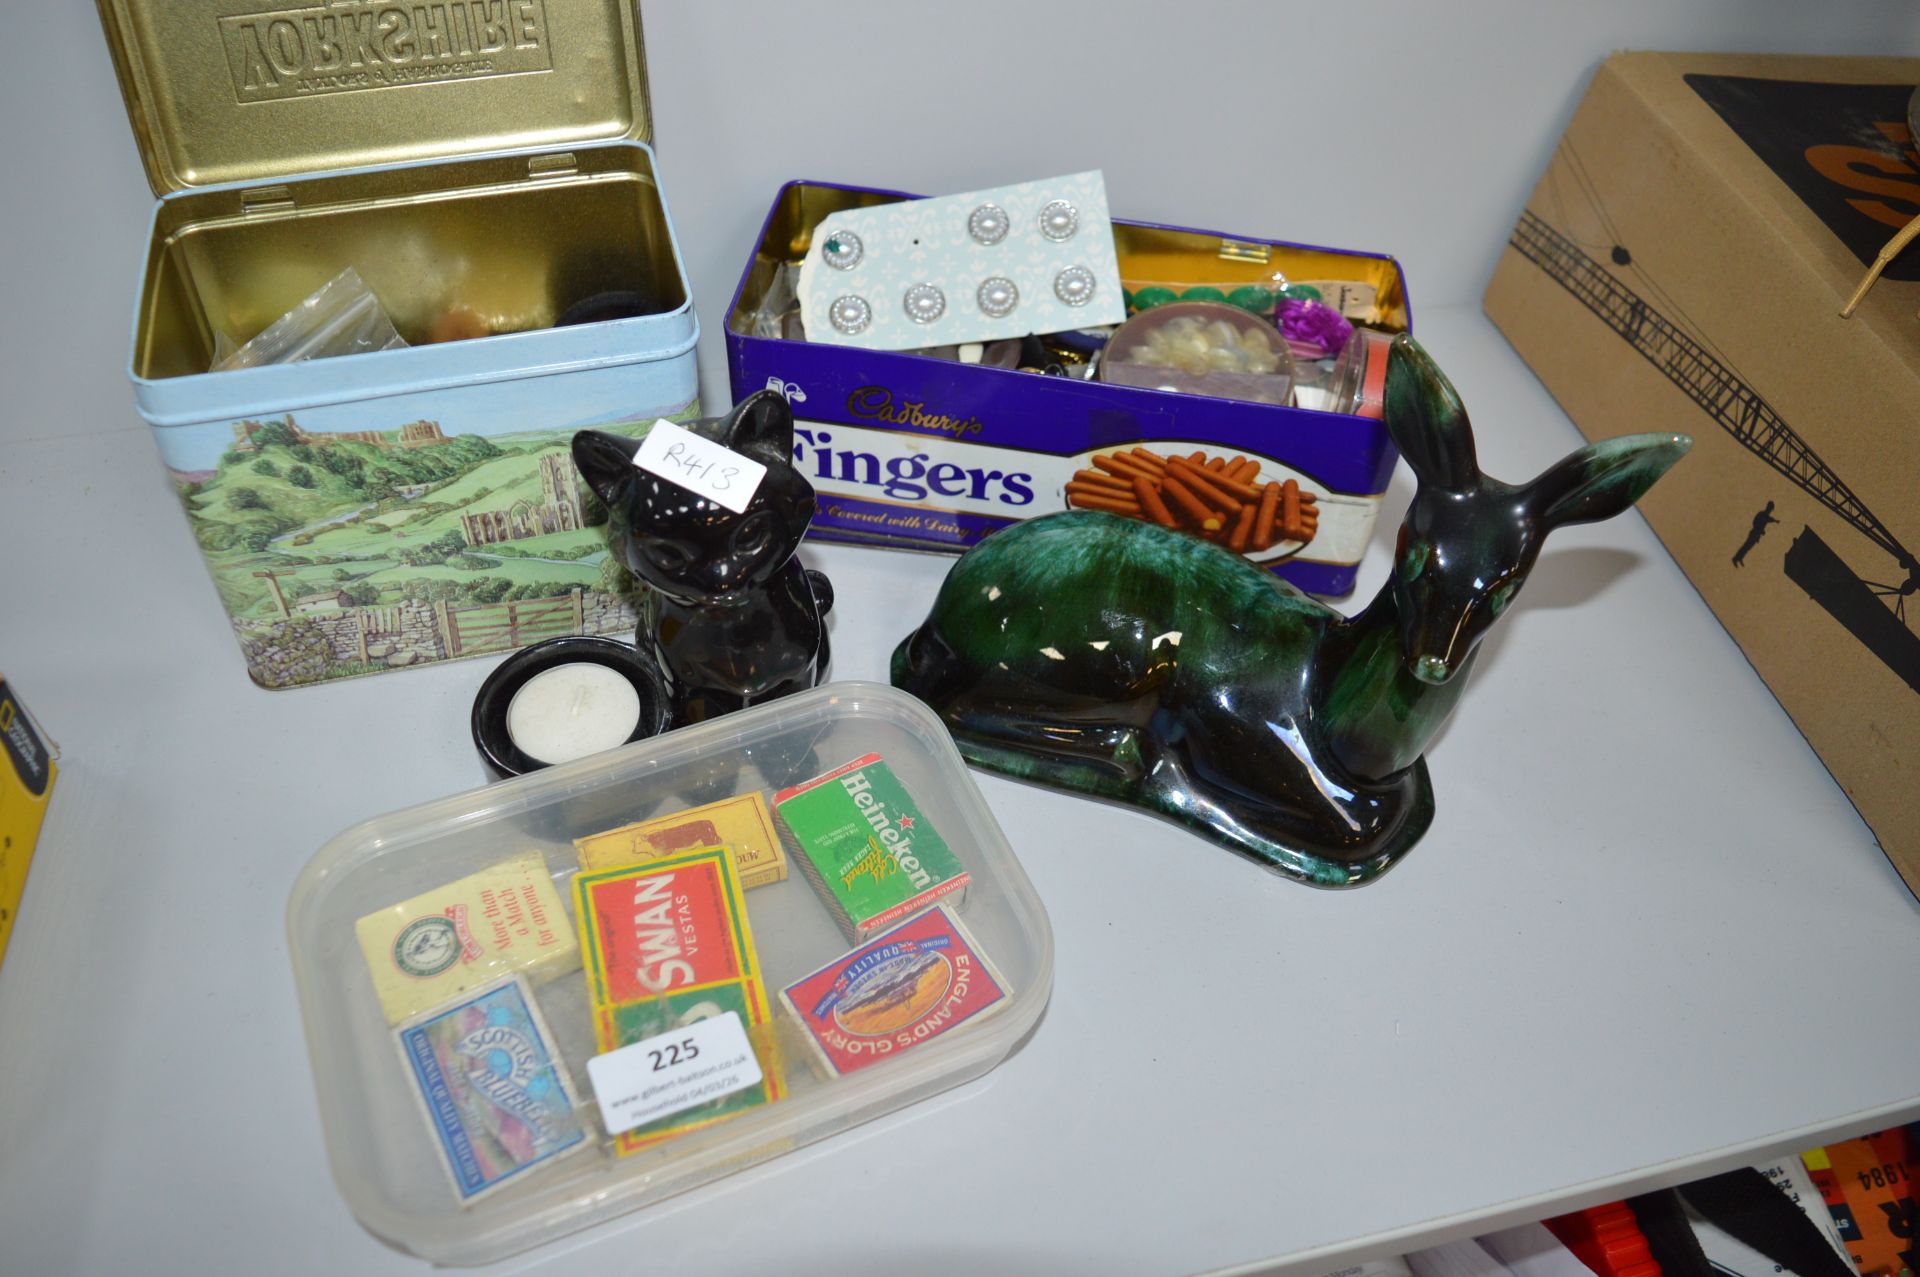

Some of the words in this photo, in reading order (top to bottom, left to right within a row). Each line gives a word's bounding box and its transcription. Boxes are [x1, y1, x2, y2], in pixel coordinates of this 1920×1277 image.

[846, 385, 983, 437] Cadbury's
[662, 442, 740, 490] R413
[827, 501, 885, 524] Covered
[888, 514, 921, 529] with
[924, 517, 971, 538] Dairy
[840, 770, 931, 890] Heineken
[841, 832, 884, 892] filtered
[870, 853, 897, 886] Cold
[480, 888, 502, 920] than
[498, 887, 526, 925] Match
[521, 884, 548, 926] anyone
[489, 919, 514, 951] More
[515, 927, 530, 937] a
[537, 927, 560, 947] for
[634, 872, 696, 992] SWAN
[675, 895, 698, 957] VESTAS
[848, 945, 901, 980] QUALITY
[897, 953, 971, 1046] ENGLAND'S
[469, 1029, 534, 1084] SCOTTISH
[648, 1038, 700, 1072] 225
[821, 1028, 893, 1055] GLORY
[1857, 1161, 1910, 1191] 1984
